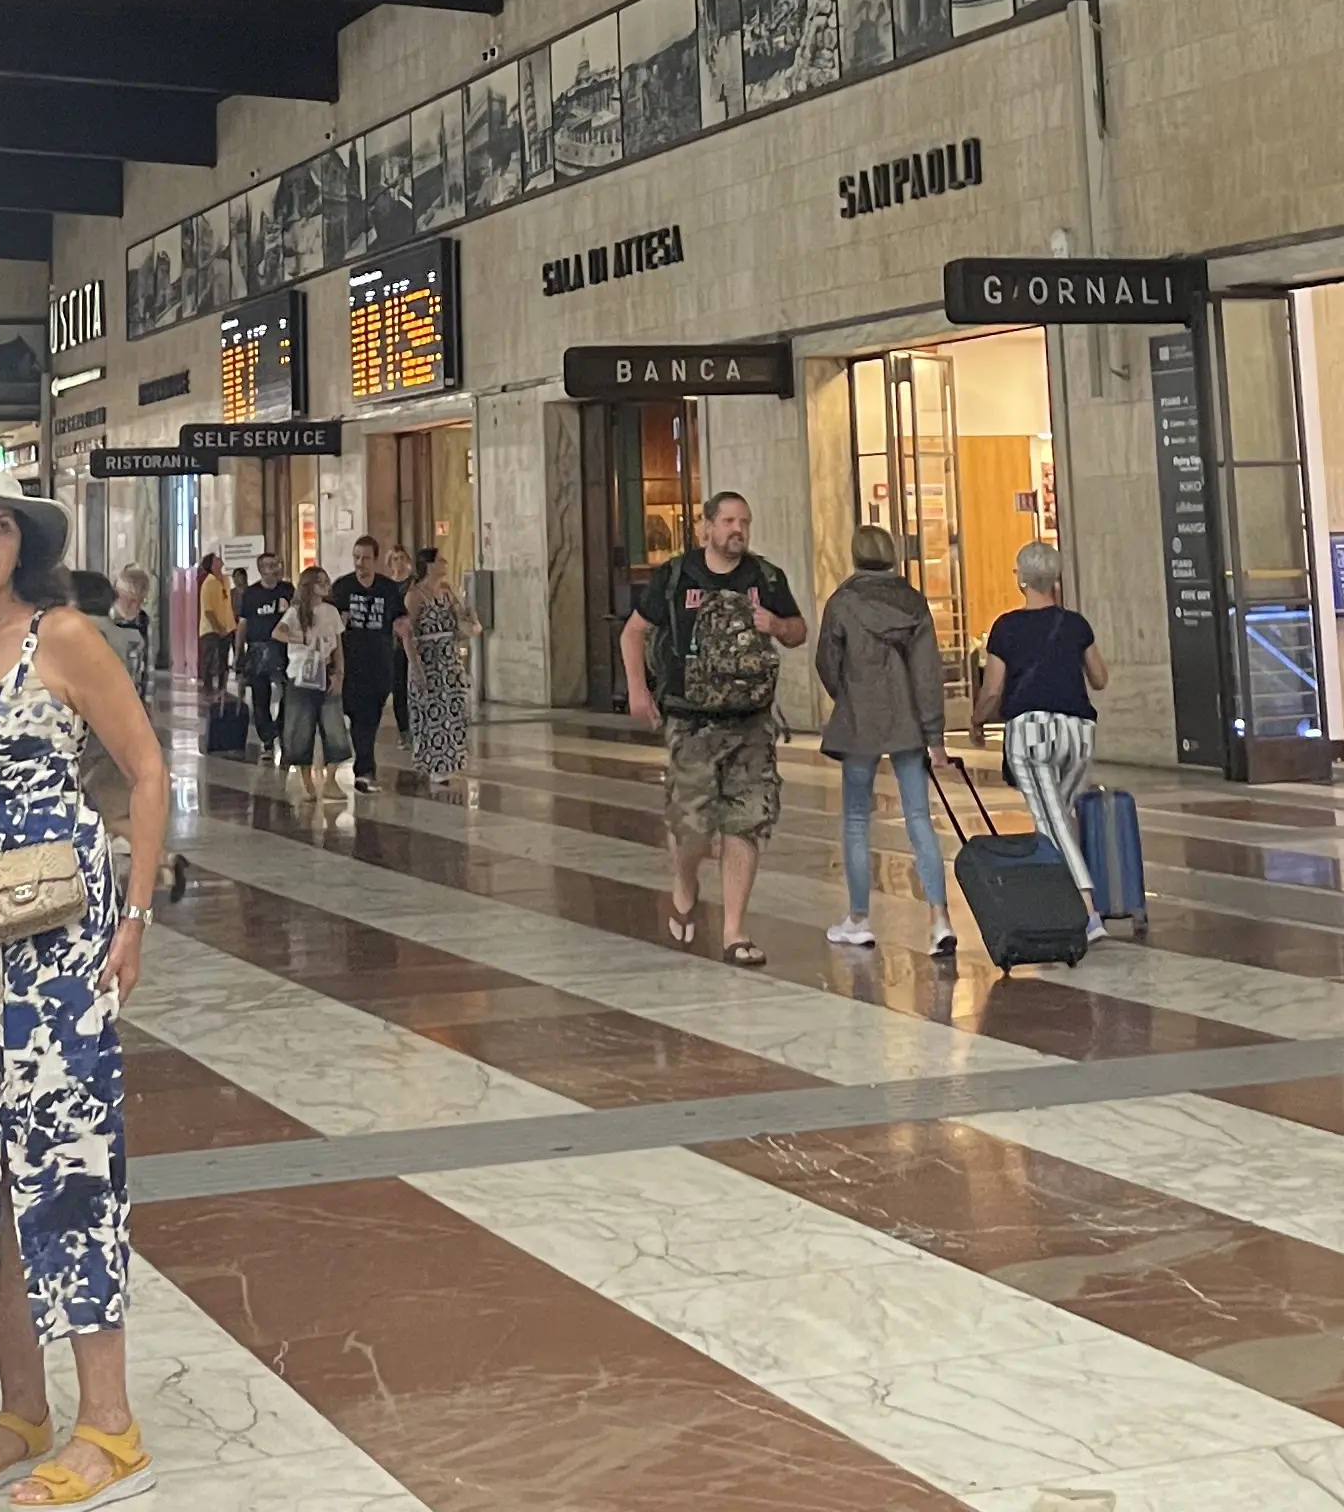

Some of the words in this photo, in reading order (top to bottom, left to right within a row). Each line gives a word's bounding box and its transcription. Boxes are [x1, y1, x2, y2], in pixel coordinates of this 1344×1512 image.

[838, 138, 984, 219] SANPAOLO
[542, 251, 586, 297] SALA
[587, 245, 609, 286] DI
[612, 225, 685, 279] ATTESA
[49, 279, 105, 355] USCITA
[615, 357, 743, 384] BANCA
